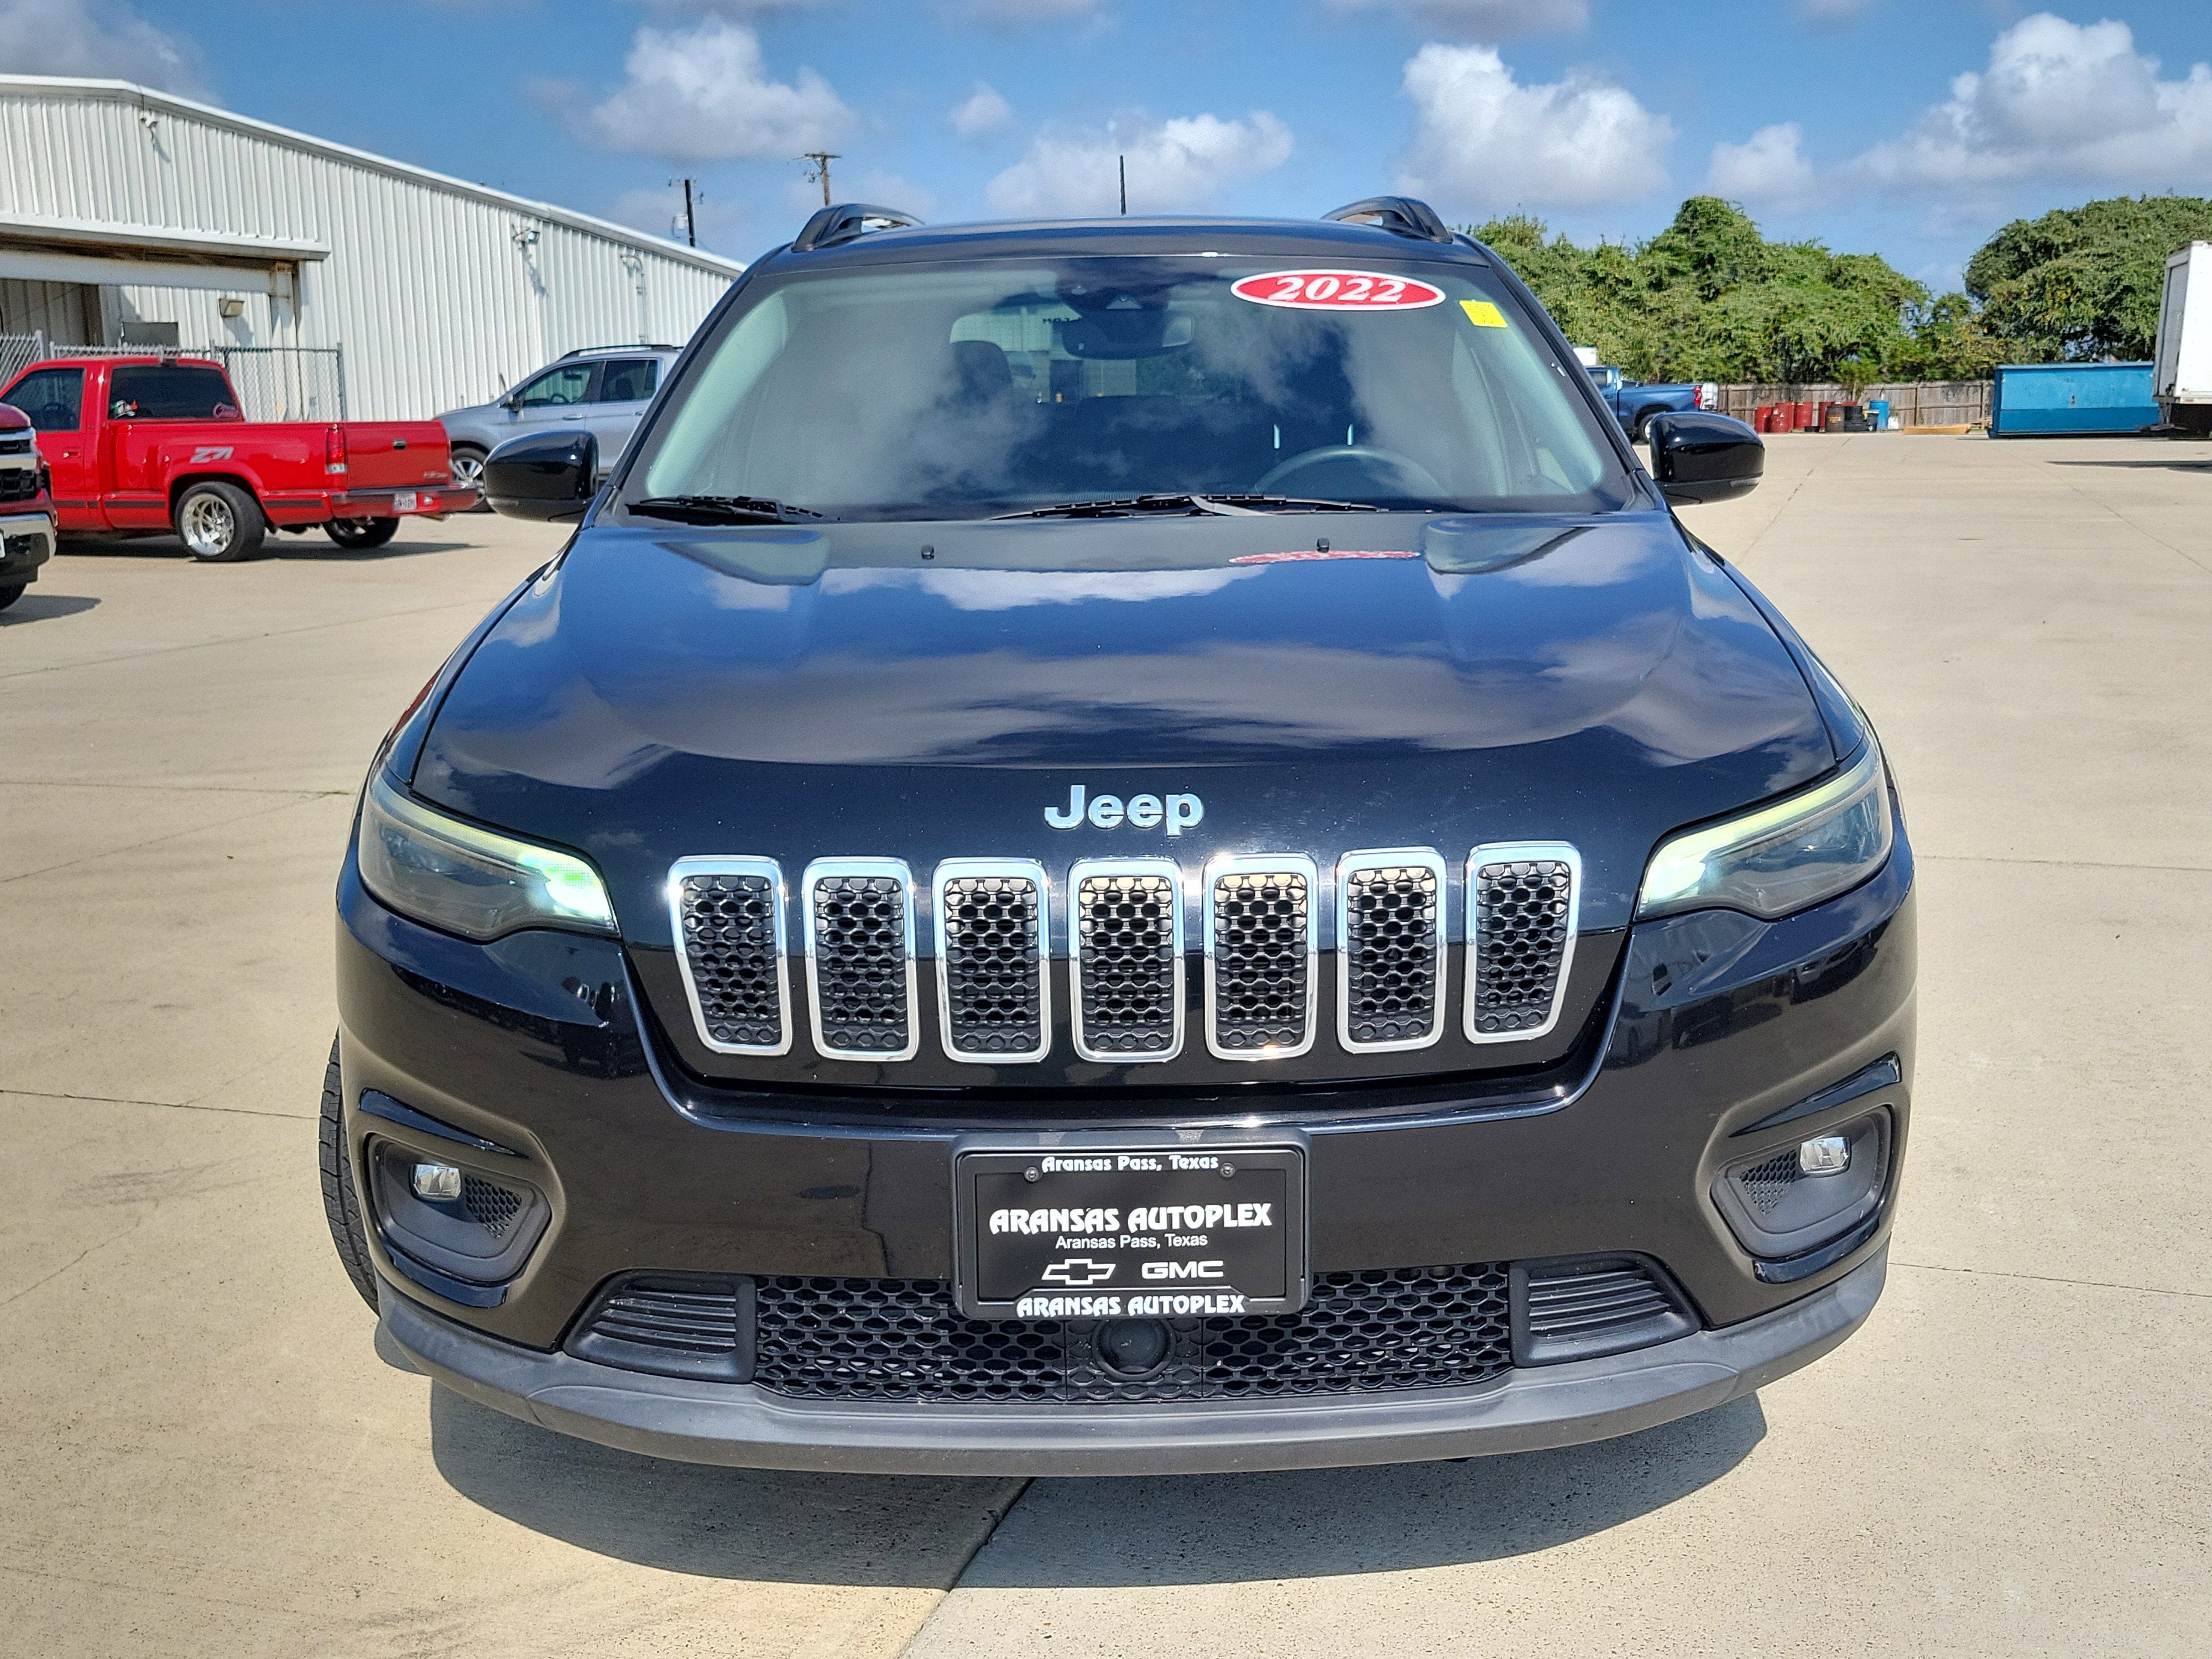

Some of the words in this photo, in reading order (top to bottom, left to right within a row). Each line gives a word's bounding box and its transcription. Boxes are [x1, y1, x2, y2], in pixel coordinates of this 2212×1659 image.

[1267, 276, 1408, 302] 2022
[1044, 784, 1203, 837] Jeep
[1041, 1156, 1112, 1173] Aransas
[1117, 1156, 1162, 1171] Pass,
[1168, 1155, 1218, 1170] Texas
[989, 1208, 1120, 1235] ARANSAS
[1128, 1203, 1273, 1234] AUTOPLEX
[1055, 1235, 1116, 1249] Aransas
[1120, 1235, 1161, 1250] Pass,
[1164, 1233, 1208, 1248] Texas
[1141, 1260, 1224, 1280] GMC
[1016, 1296, 1121, 1318] ARANSAS
[1127, 1294, 1245, 1317] AUTOPLEX
